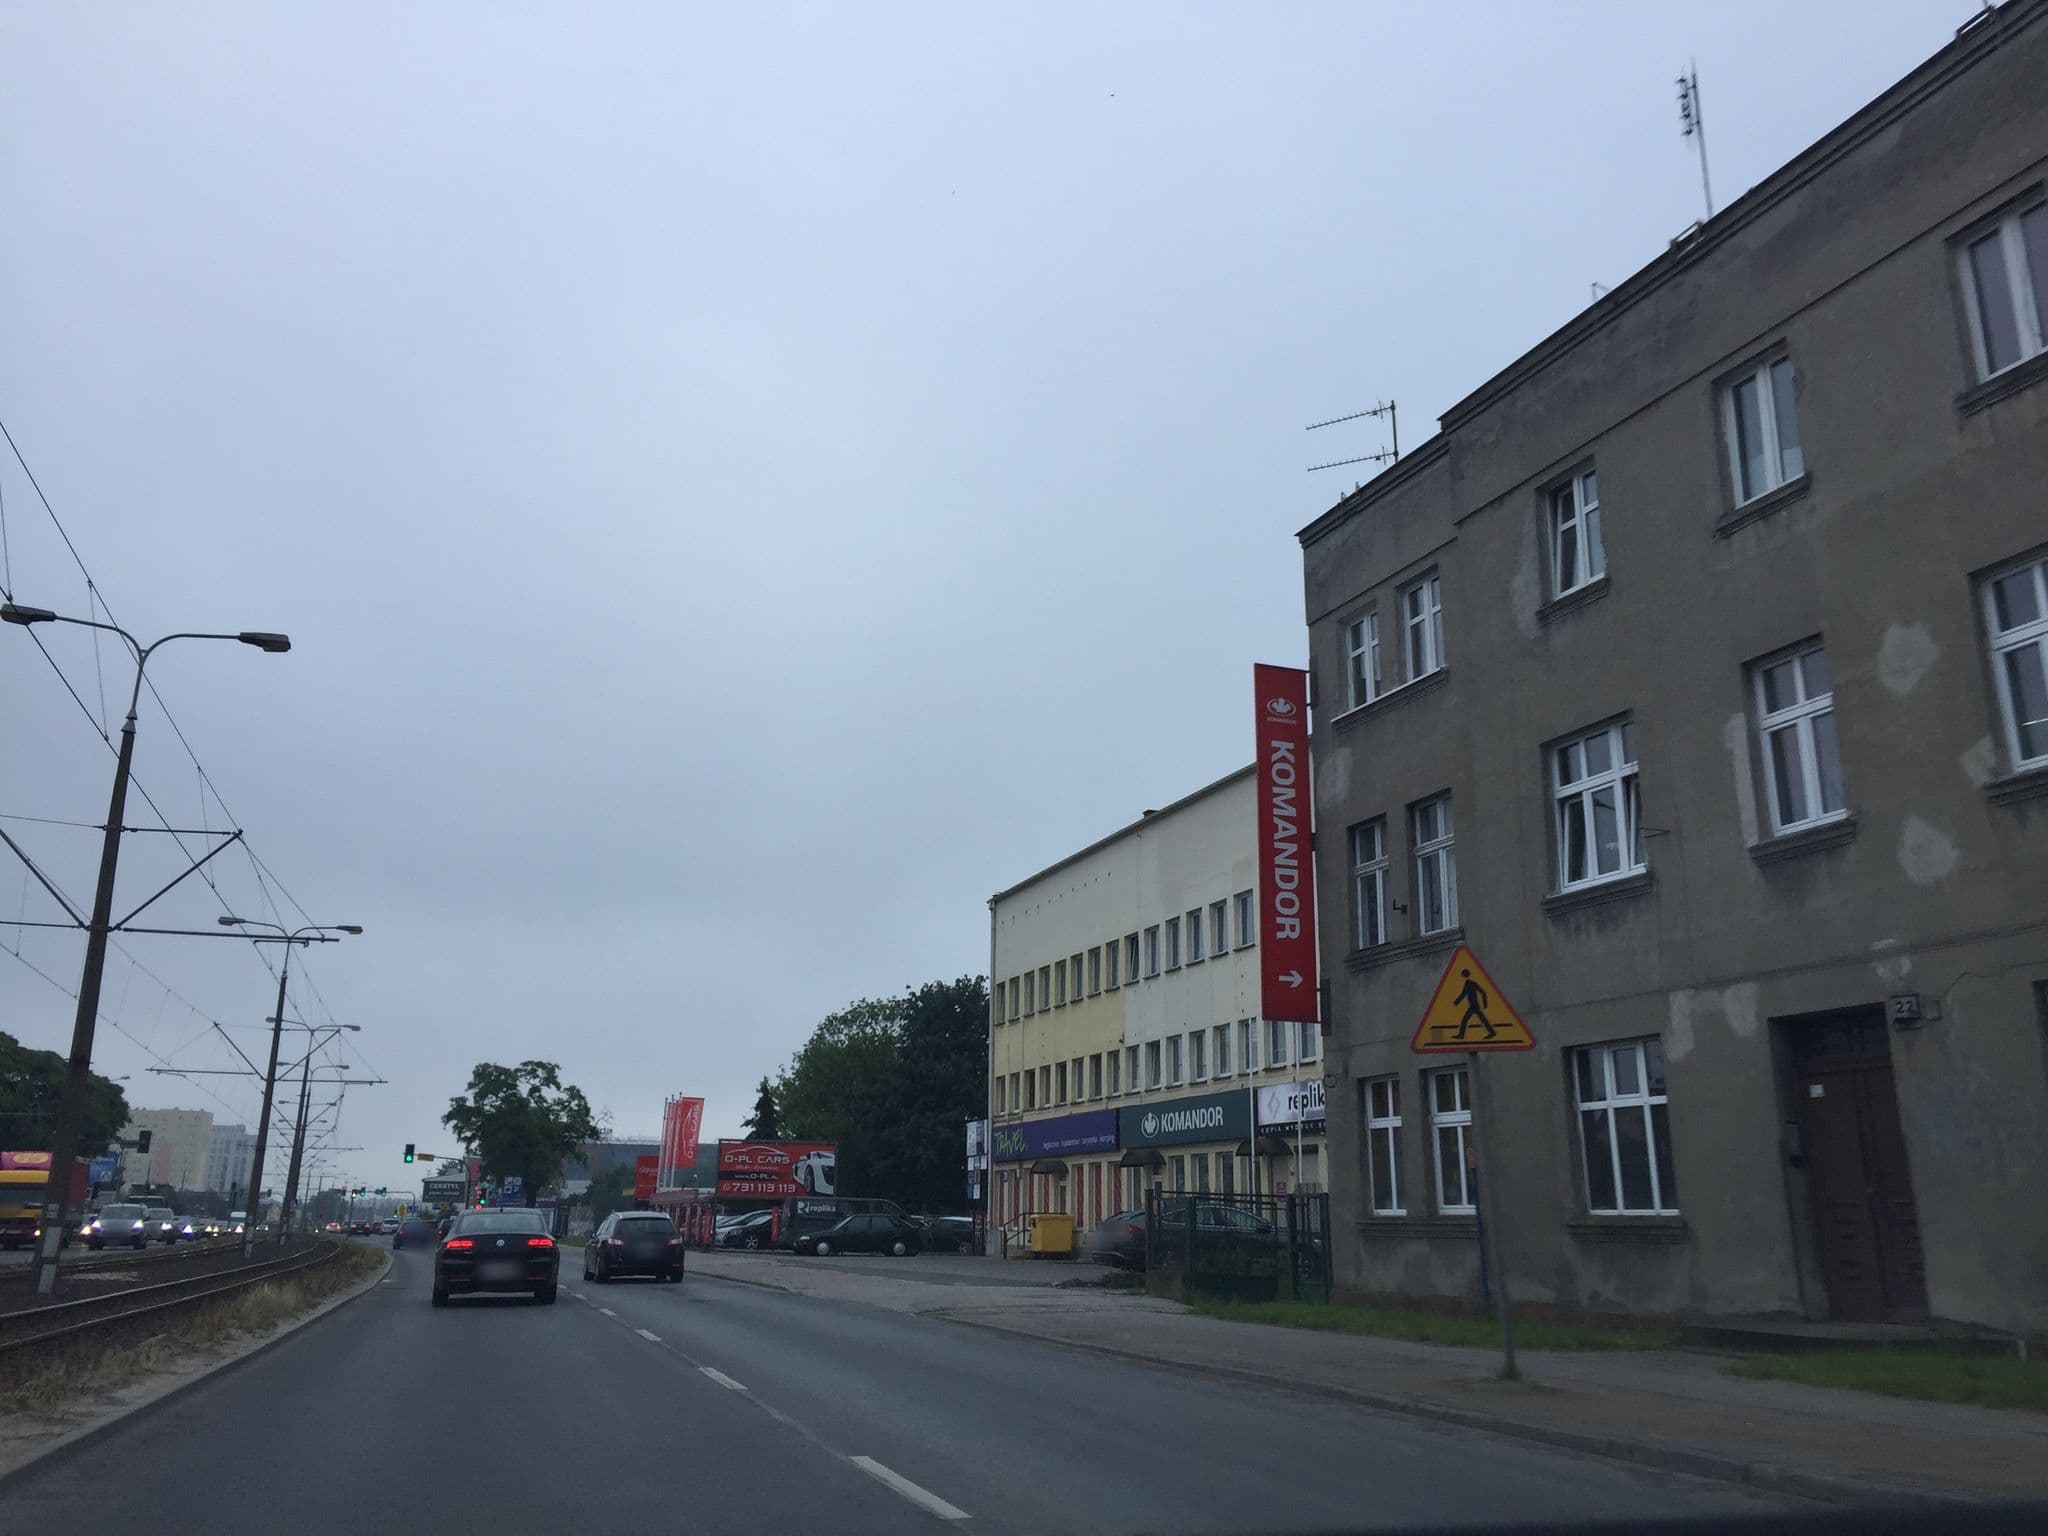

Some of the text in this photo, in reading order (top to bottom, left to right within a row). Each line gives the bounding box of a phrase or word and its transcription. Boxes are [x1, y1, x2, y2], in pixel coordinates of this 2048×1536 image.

[1271, 740, 1301, 940] KOMANDOR
[1160, 1105, 1224, 1133] KOMANDOR
[757, 1155, 790, 1165] CARS
[732, 1182, 796, 1193] 731 113 113
